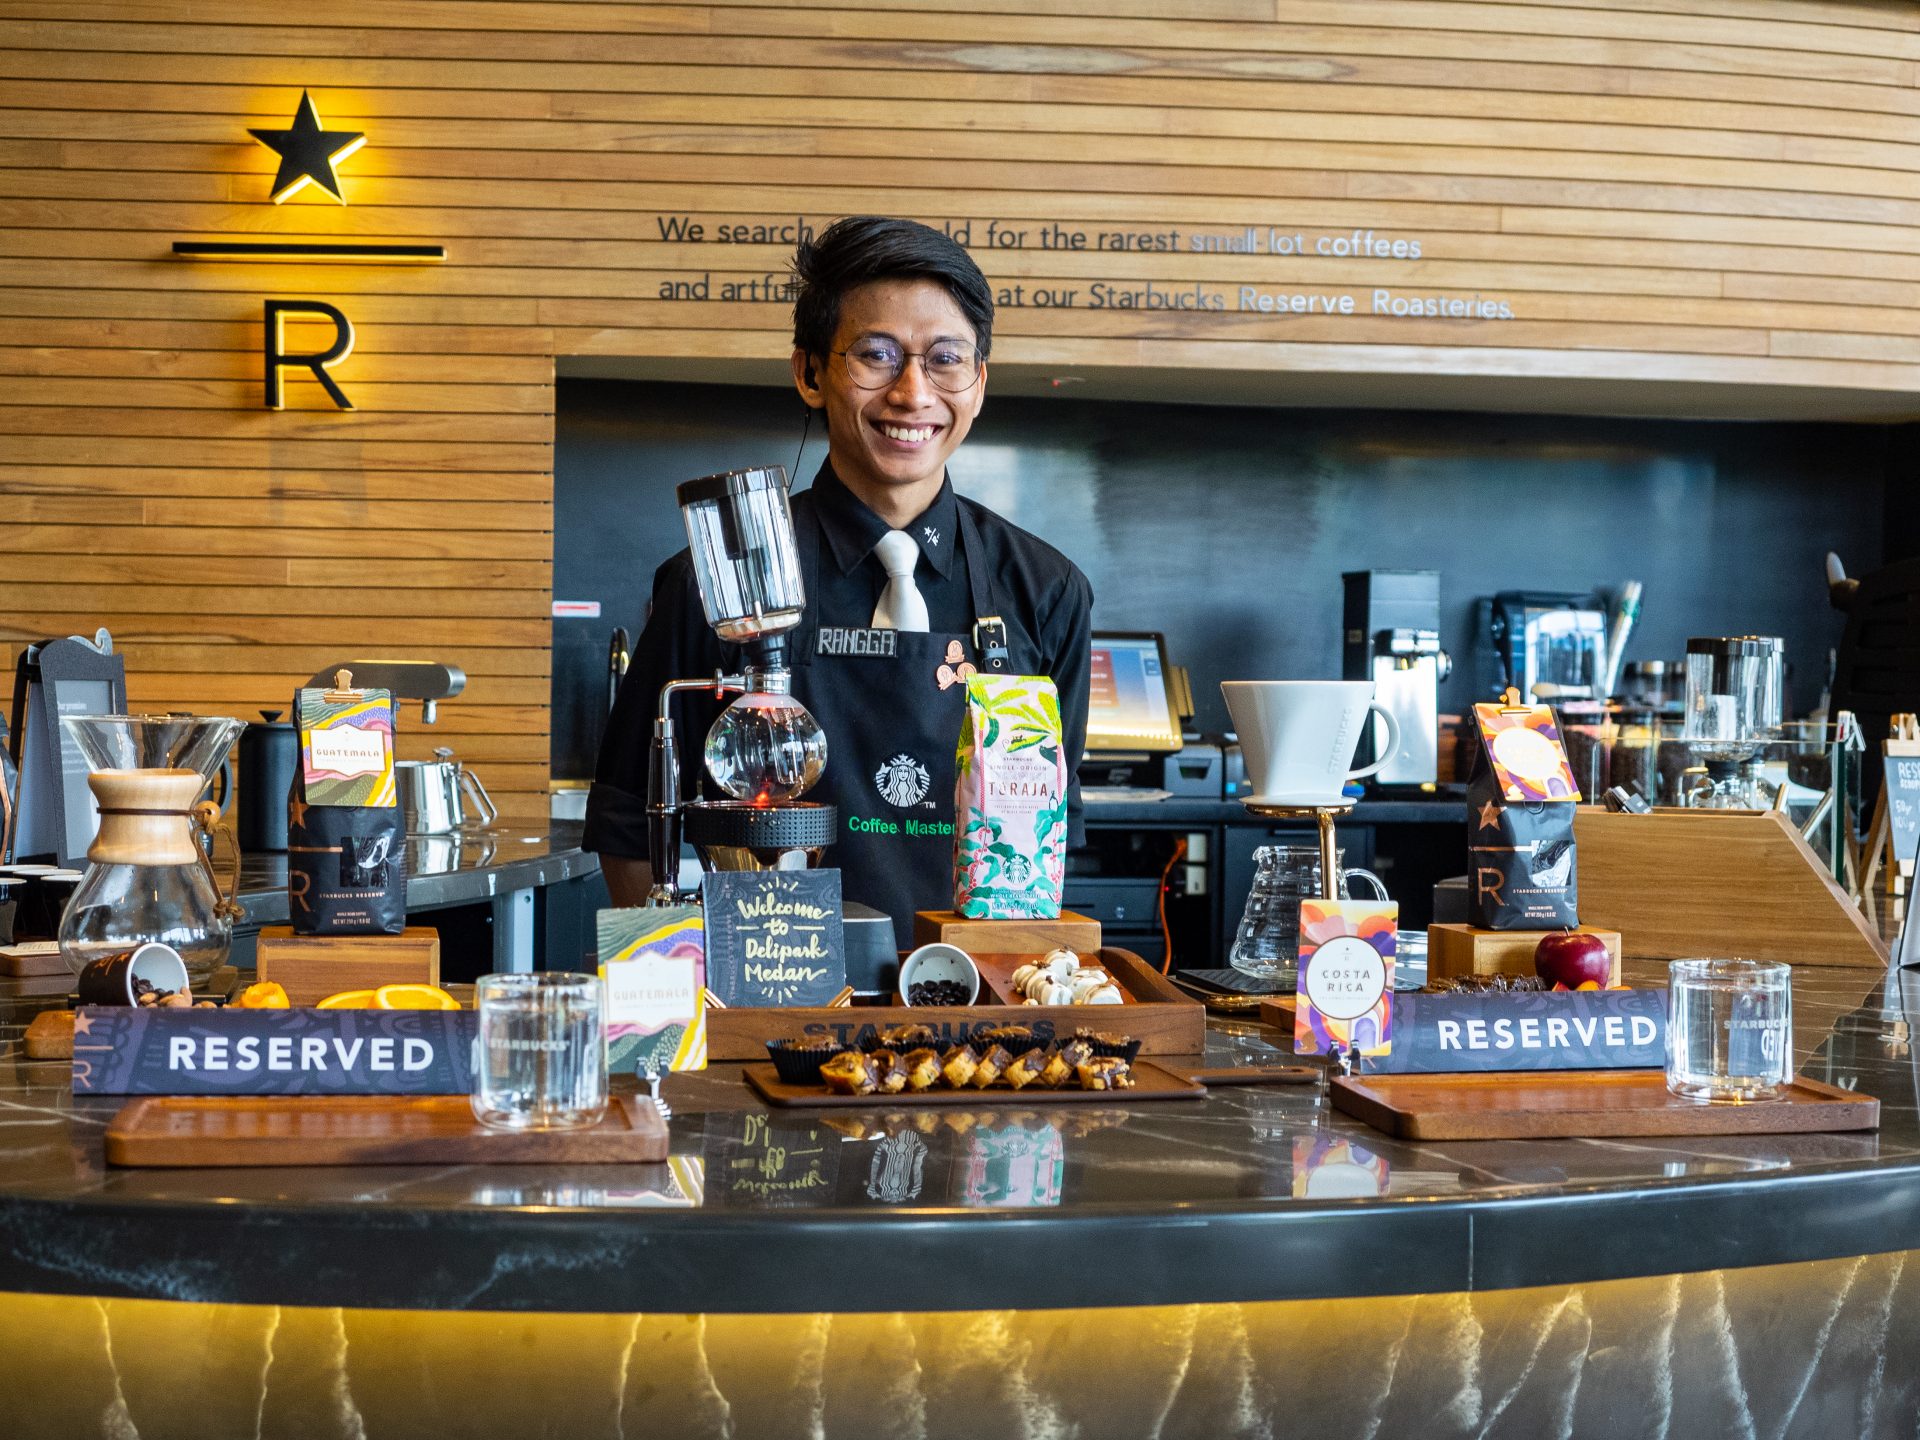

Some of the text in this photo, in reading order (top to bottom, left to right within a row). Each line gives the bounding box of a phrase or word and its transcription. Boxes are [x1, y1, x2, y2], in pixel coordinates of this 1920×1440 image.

[657, 216, 704, 242] We
[718, 217, 814, 244] search
[987, 220, 1027, 249] for
[1041, 222, 1087, 250] the
[1099, 230, 1181, 252] rarest
[1316, 229, 1423, 259] coffees
[659, 272, 709, 300] and
[997, 285, 1025, 306] at
[1033, 288, 1078, 308] our
[1089, 282, 1225, 311] Starbucks
[1238, 286, 1355, 314] Reserve
[1371, 289, 1515, 320] Roasteries.
[264, 299, 357, 412] R
[817, 628, 896, 655] RANGGA
[316, 748, 380, 757] GUATEMALA
[848, 816, 898, 834] Coffee
[289, 869, 312, 912] R
[1478, 867, 1505, 906] R
[737, 892, 834, 919] Welcome
[763, 918, 788, 936] to
[745, 933, 829, 963] Delipark
[744, 963, 827, 982] Medan
[1322, 970, 1371, 979] COSTA
[614, 988, 689, 1000] GUATEMALA
[1327, 983, 1363, 992] RICA
[1437, 1016, 1657, 1050] RESERVED
[1723, 1019, 1789, 1030] STARBUC
[169, 1036, 434, 1071] RESERVED
[489, 1039, 570, 1052] STARBUCKS
